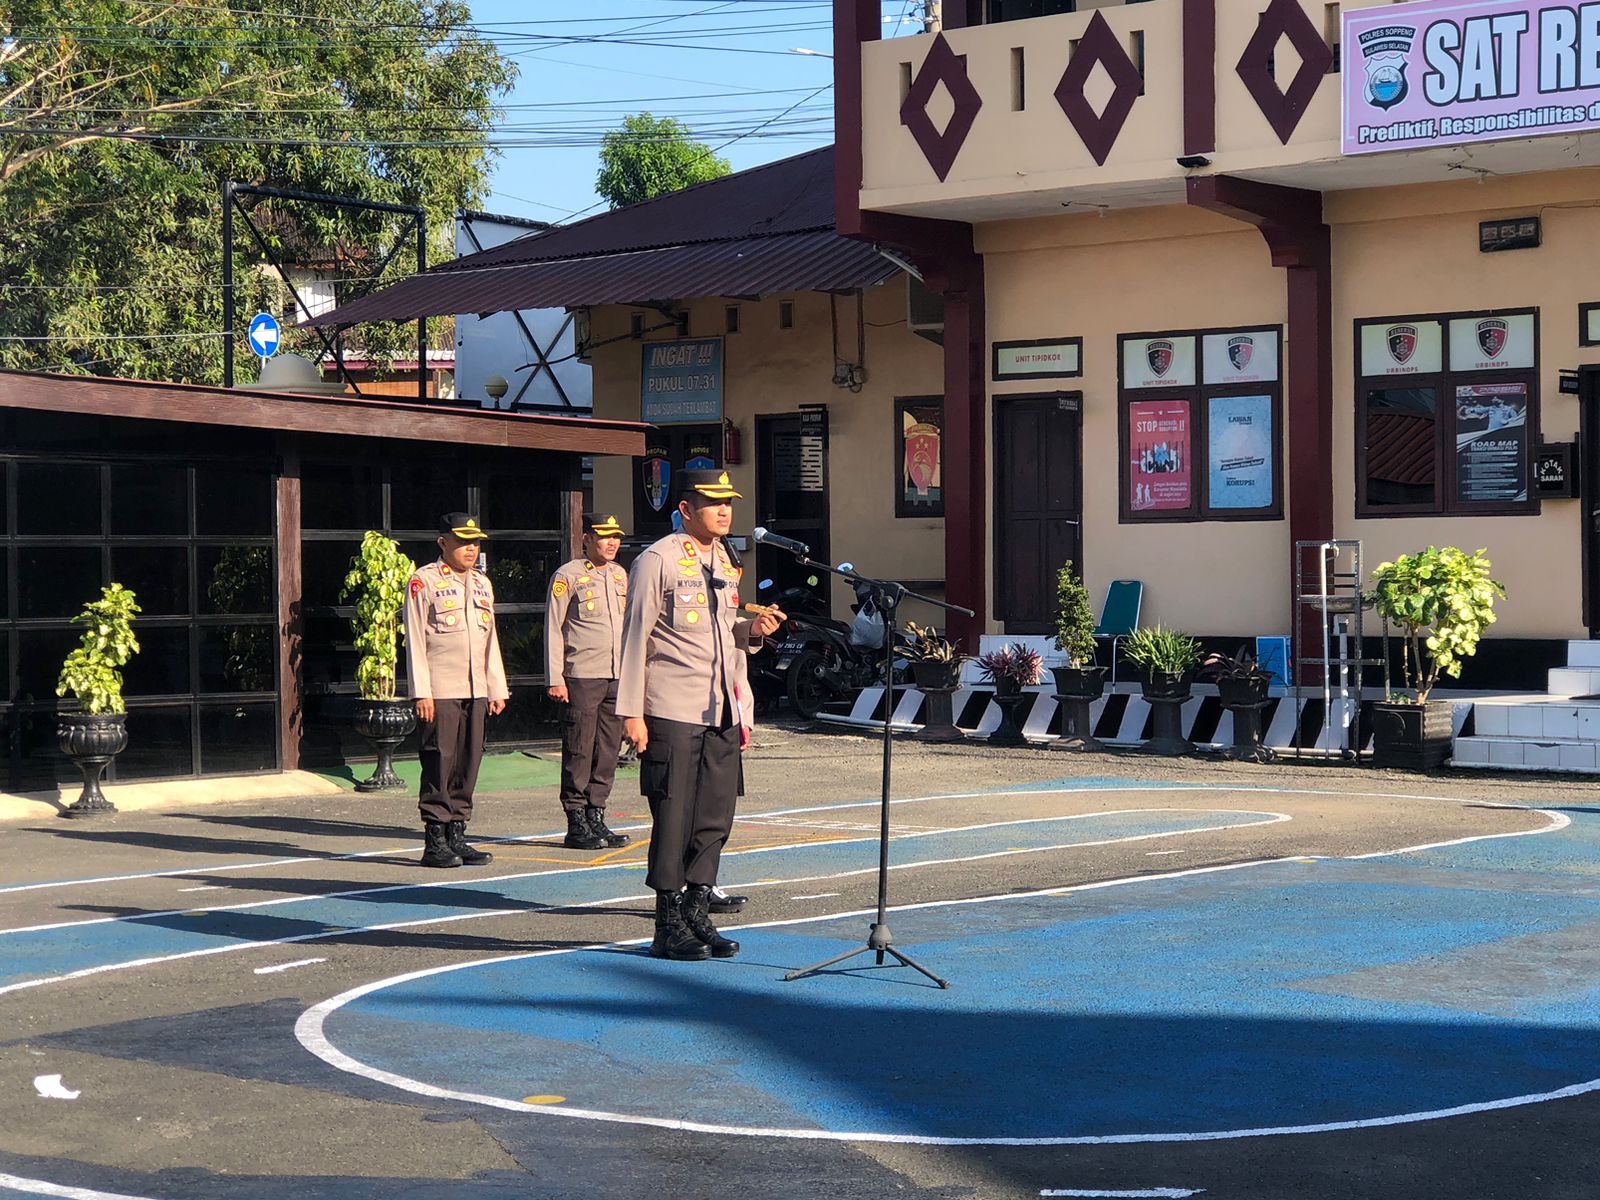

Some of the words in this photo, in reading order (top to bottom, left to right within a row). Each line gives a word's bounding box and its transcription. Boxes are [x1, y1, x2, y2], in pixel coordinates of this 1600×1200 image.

[1361, 29, 1385, 42] POLRES
[1385, 28, 1413, 36] SOPPENG
[1424, 11, 1529, 106] SAT
[1358, 119, 1438, 144] Prediktif,
[1440, 105, 1585, 135] Responsibilitas
[651, 345, 696, 368] INGAT
[1015, 355, 1031, 363] UNIT
[648, 376, 685, 393] PUKUL
[687, 374, 716, 392] 07.31
[1136, 421, 1158, 433] STOP
[1540, 459, 1563, 475] KOTAK
